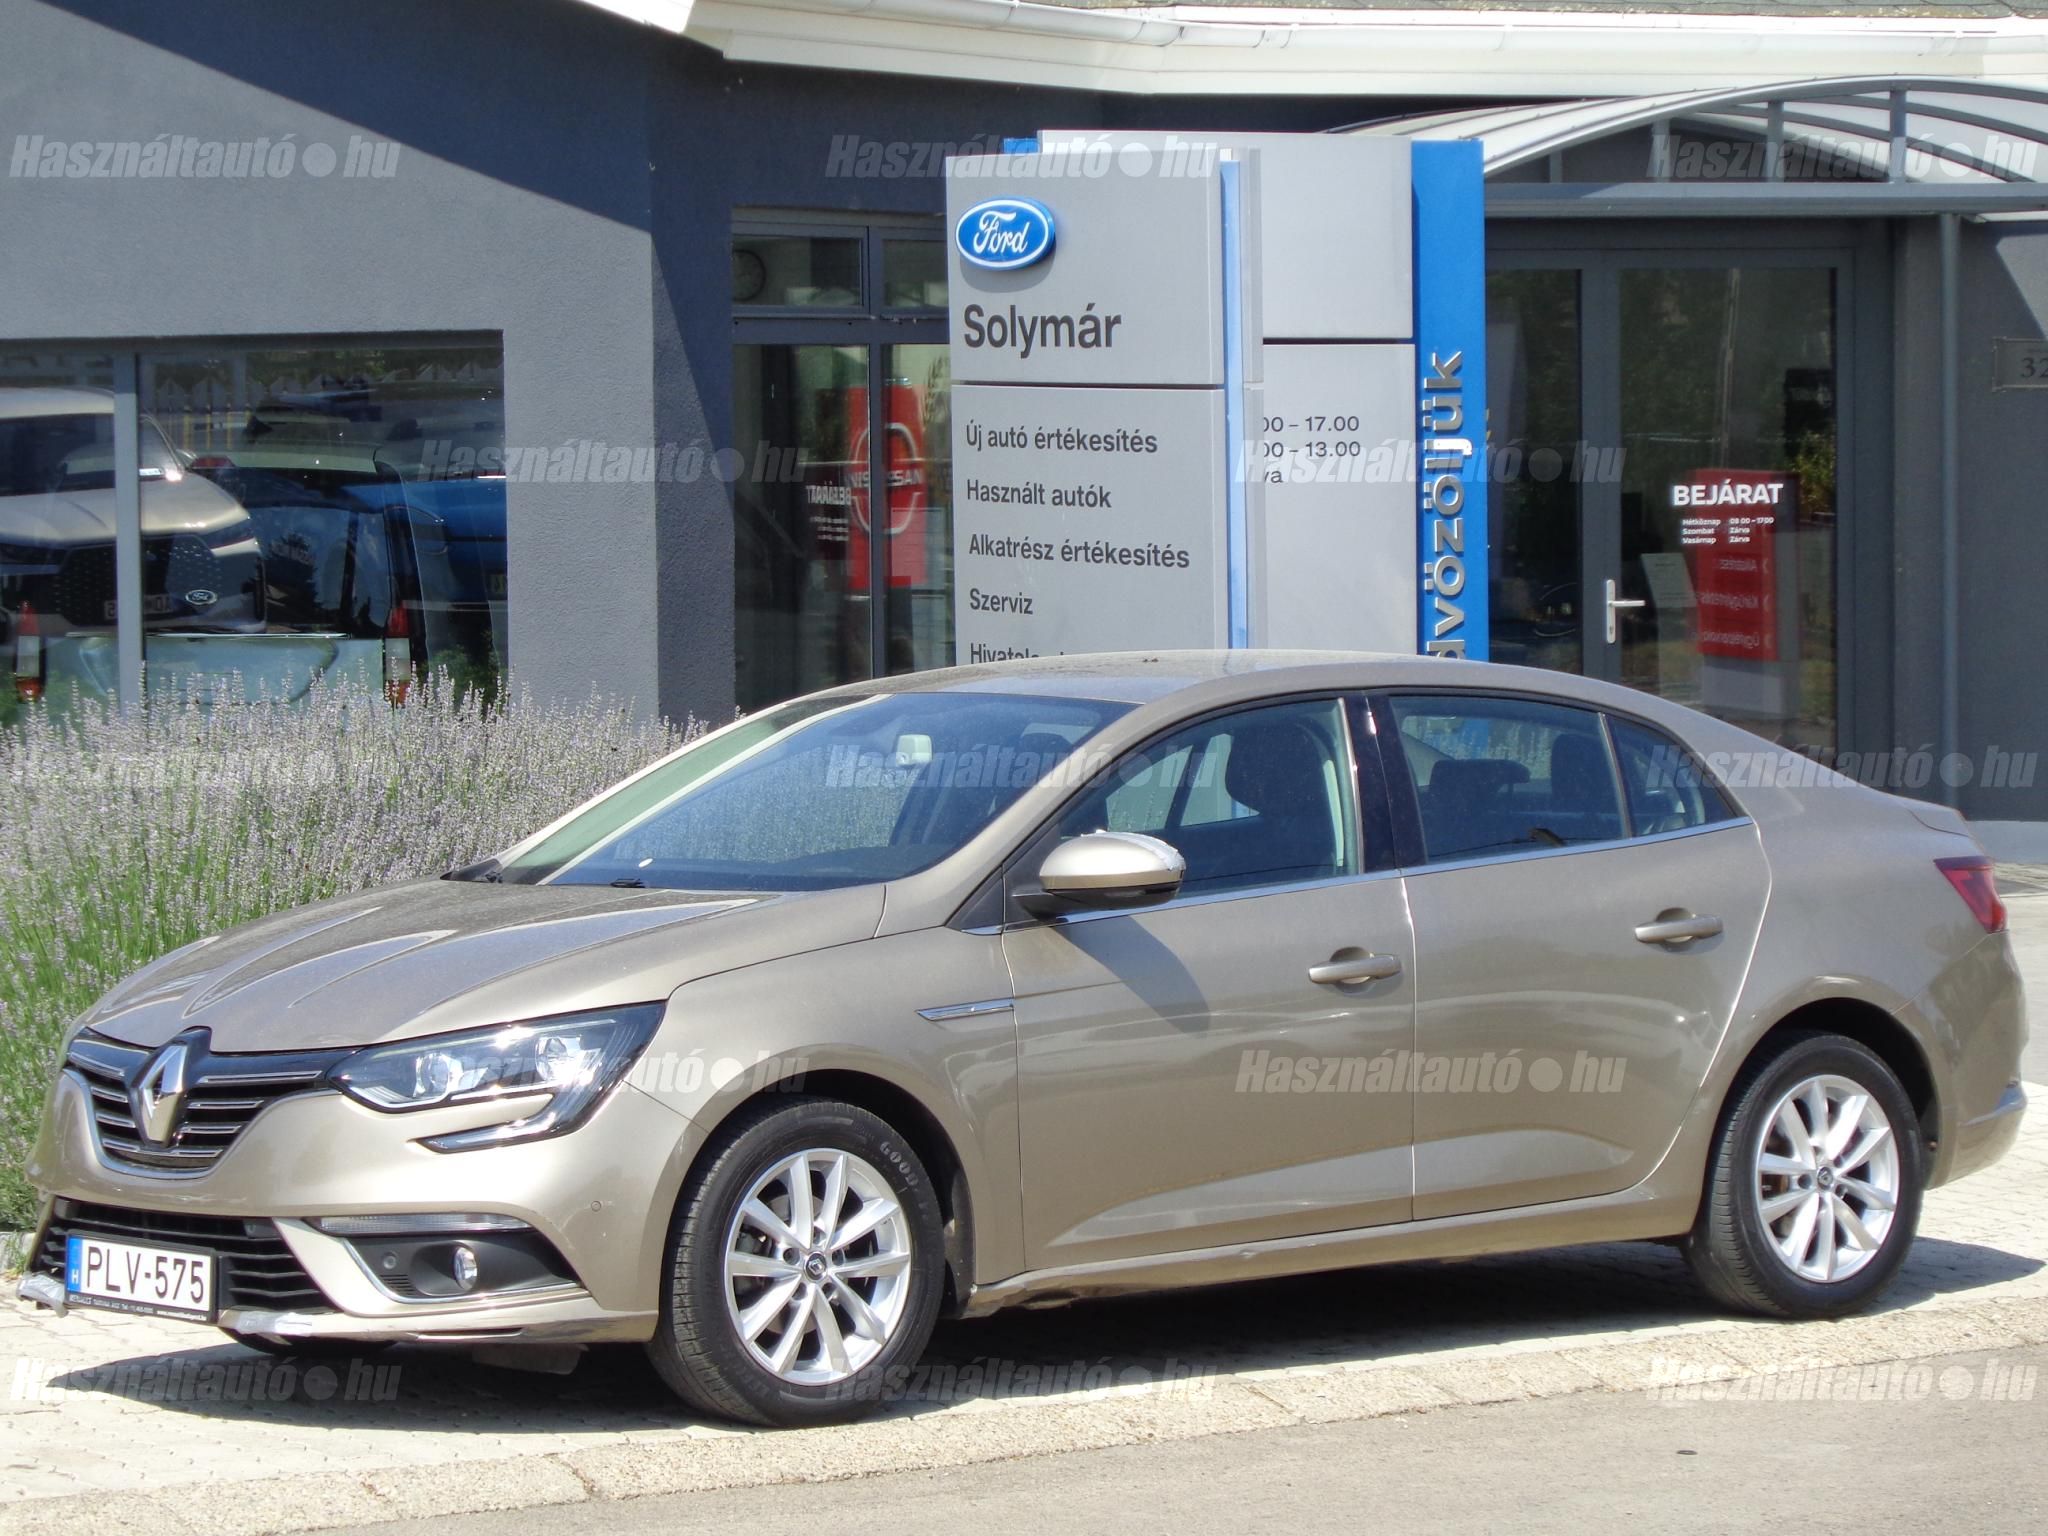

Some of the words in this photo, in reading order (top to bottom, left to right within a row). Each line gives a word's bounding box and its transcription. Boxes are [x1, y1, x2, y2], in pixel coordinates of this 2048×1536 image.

[972, 209, 1031, 255] Ford
[964, 303, 1122, 359] Solymár
[966, 419, 982, 452] Új
[988, 425, 1028, 449] autó
[1034, 426, 1158, 453] értékesítés
[1305, 415, 1360, 432] 17.00
[1305, 441, 1361, 457] 13.00
[967, 479, 1045, 505] Használt
[1051, 484, 1112, 508] autók
[1673, 479, 1784, 506] BEJÁRAT
[1682, 518, 1721, 527] Hétköznap
[1682, 527, 1715, 536] Szombat
[1729, 526, 1750, 534] Zárva
[969, 533, 1054, 561] Alkatrész
[1060, 539, 1190, 568] értékesítés
[1682, 537, 1717, 545] Vasárnap
[1729, 535, 1750, 543] Zárva
[969, 587, 1034, 615] Szerviz
[87, 1246, 204, 1303] PLV-575
